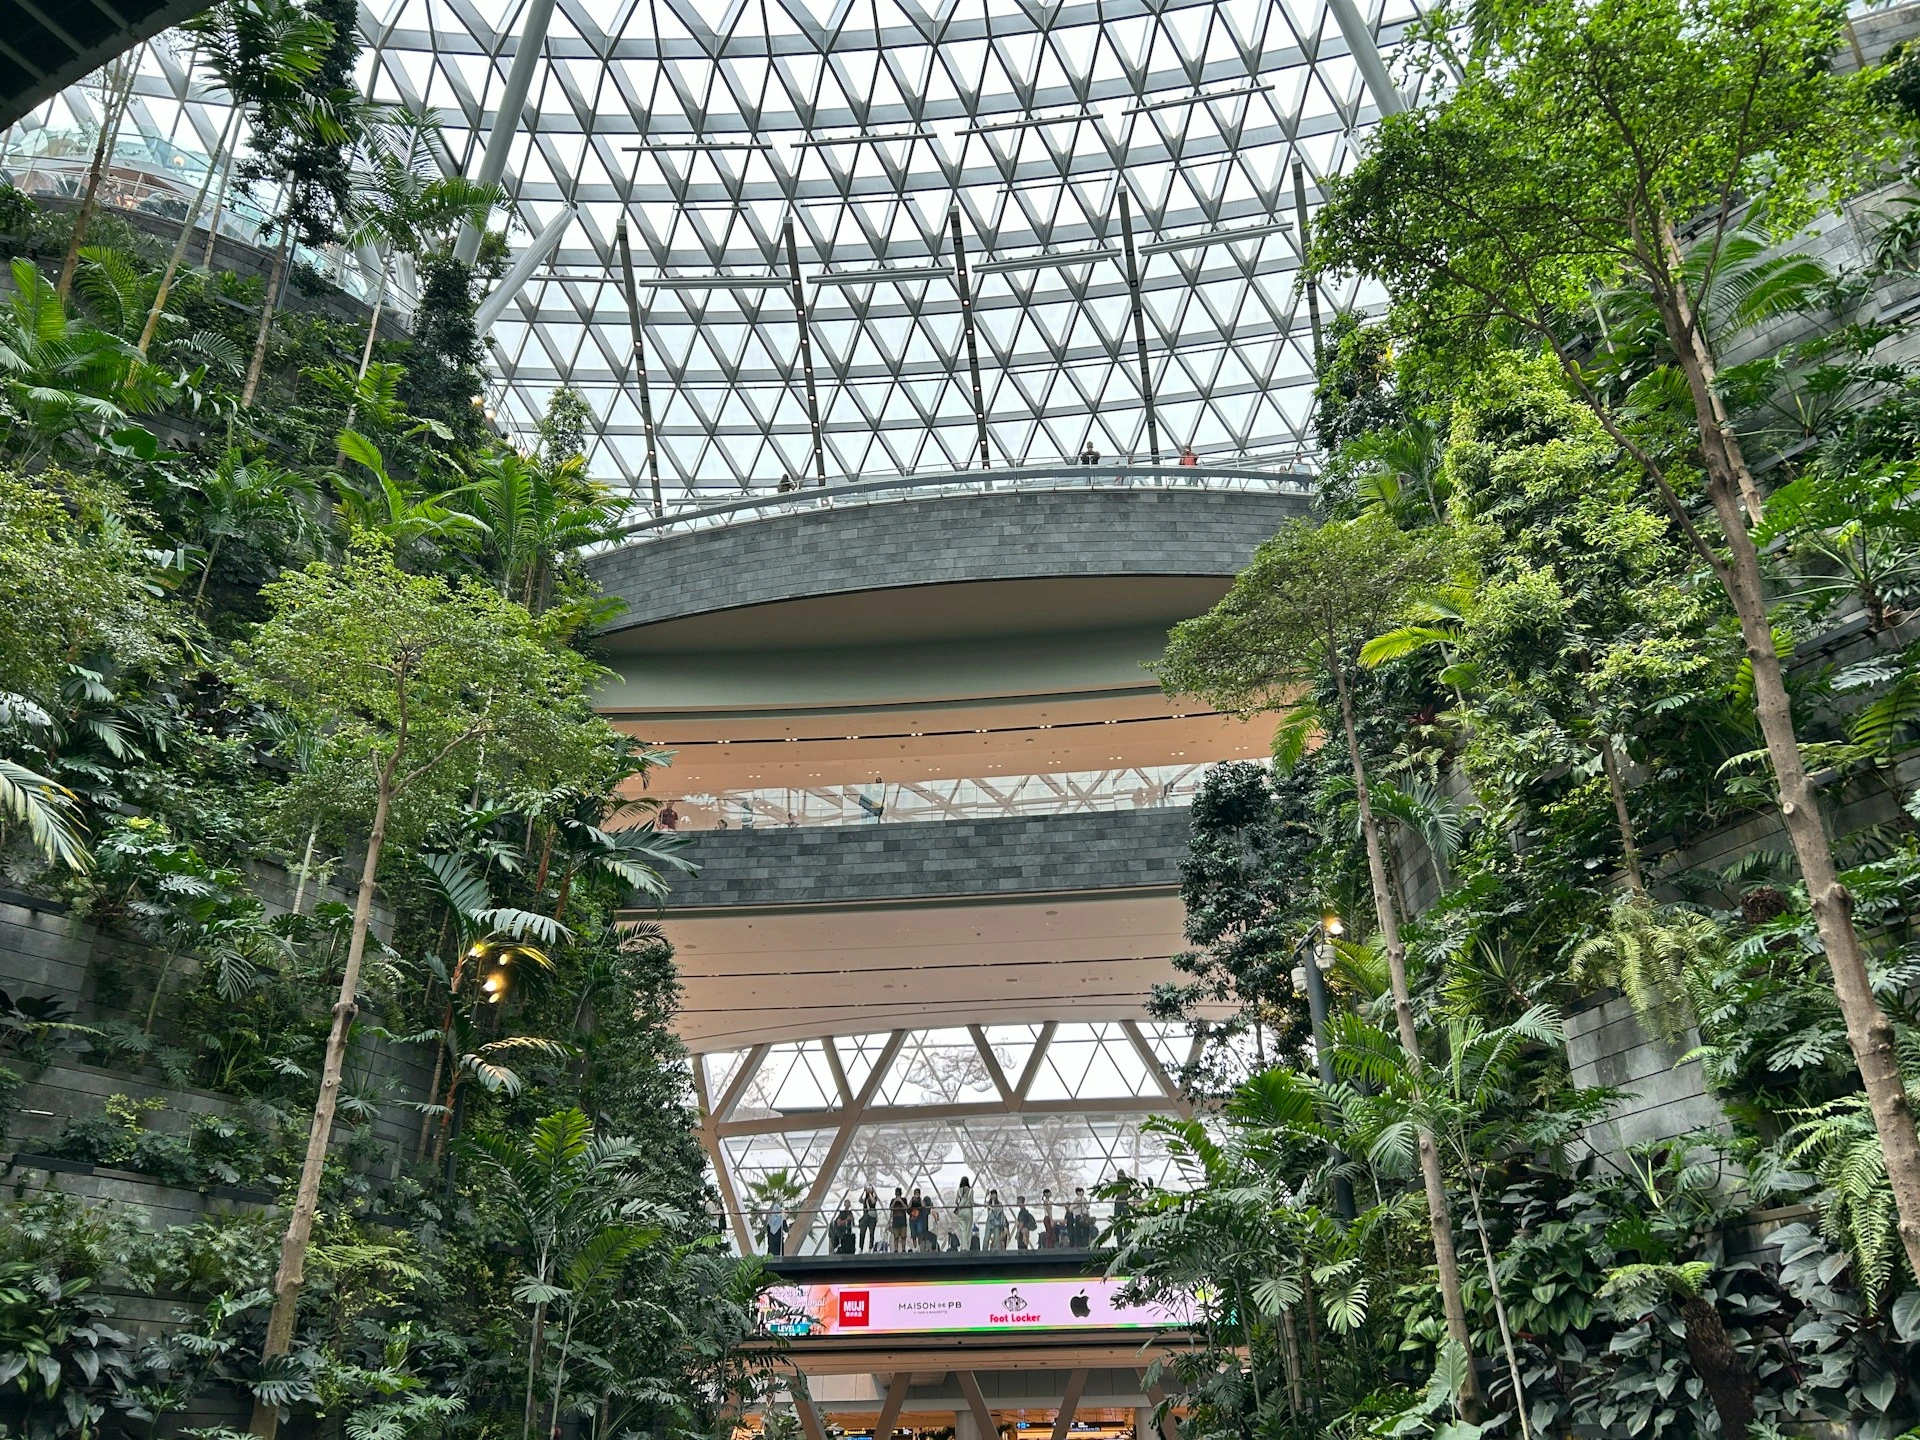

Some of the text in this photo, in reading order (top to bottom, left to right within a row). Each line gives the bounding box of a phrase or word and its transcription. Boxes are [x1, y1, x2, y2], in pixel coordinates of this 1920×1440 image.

[843, 1300, 865, 1312] MUJI
[898, 1302, 936, 1311] MAISON
[948, 1301, 962, 1309] PB
[990, 1313, 1041, 1323] Foot Locker
[777, 1325, 795, 1333] LEVEL
